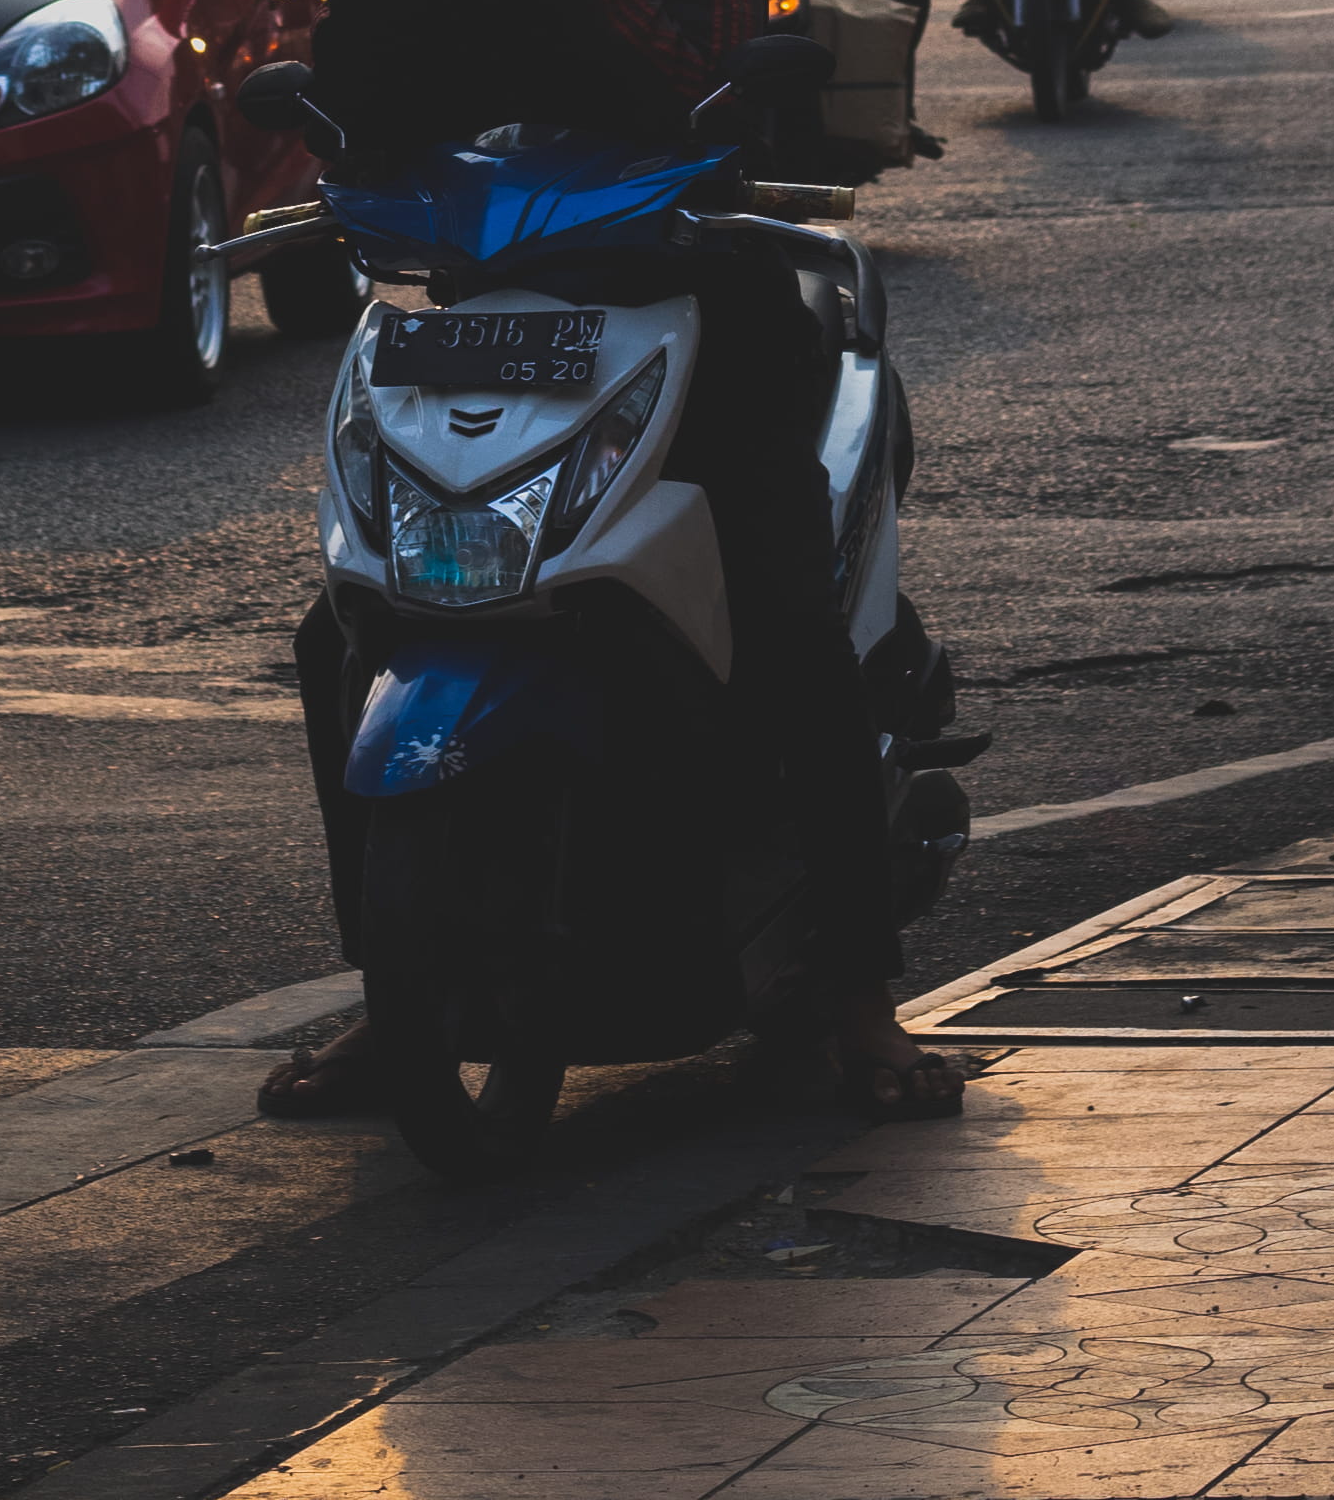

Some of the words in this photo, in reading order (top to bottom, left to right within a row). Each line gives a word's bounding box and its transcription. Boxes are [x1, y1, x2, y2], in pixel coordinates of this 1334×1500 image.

[388, 316, 408, 348] L
[441, 315, 527, 348] 3516
[500, 361, 538, 381] 05
[552, 360, 589, 380] 20
